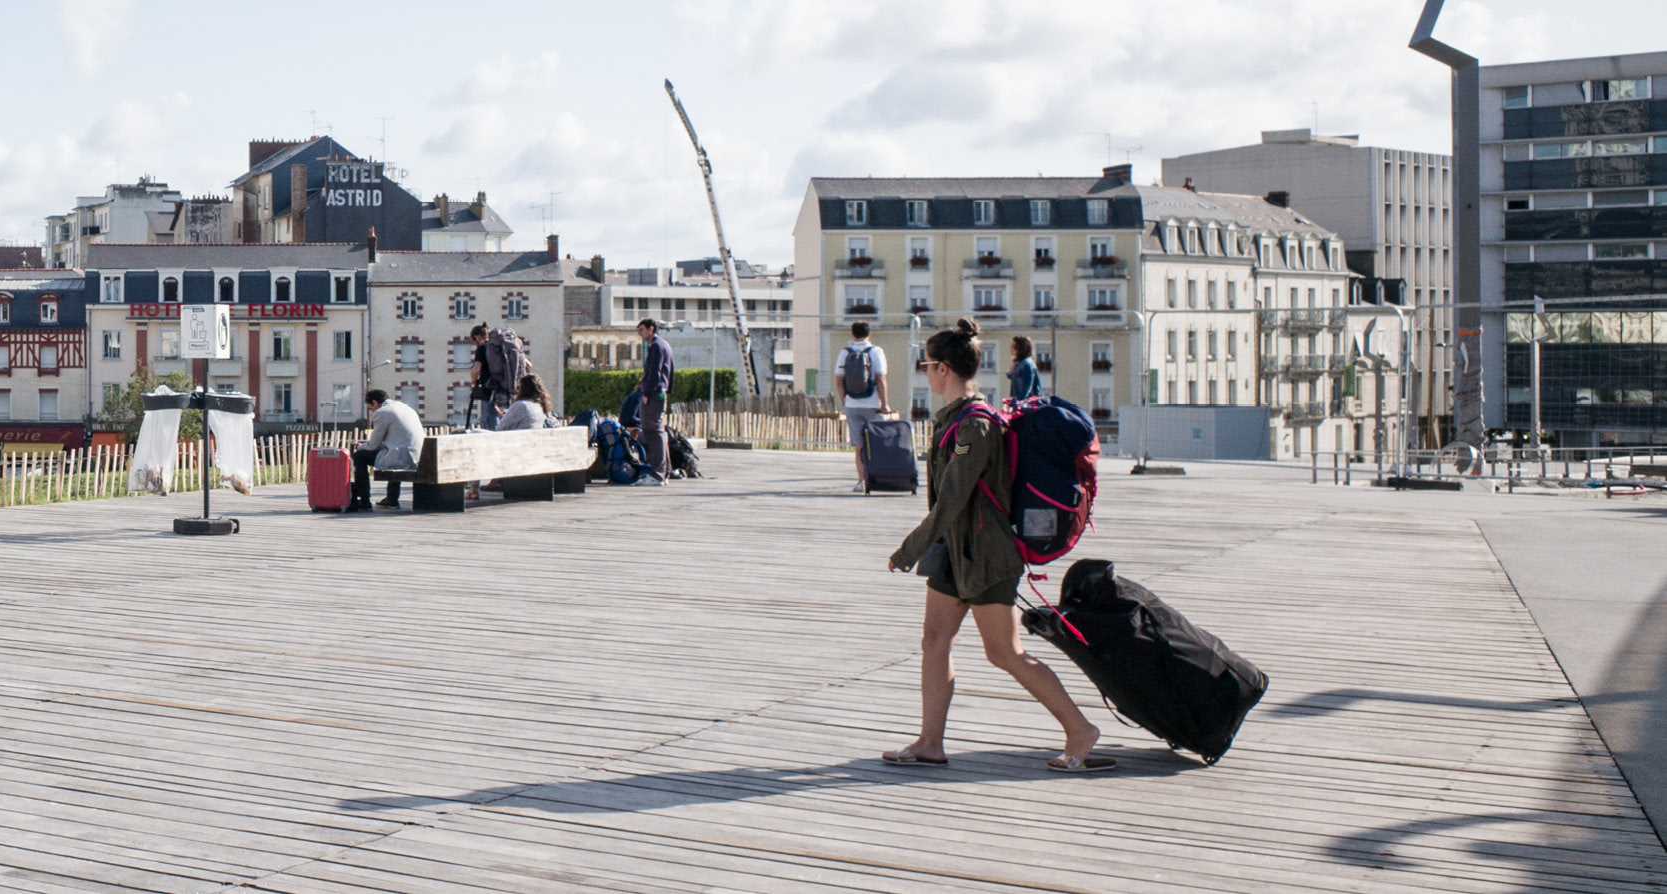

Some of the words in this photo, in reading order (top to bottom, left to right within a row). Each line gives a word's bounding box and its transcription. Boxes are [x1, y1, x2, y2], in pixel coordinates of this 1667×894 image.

[328, 165, 381, 183] HOTEL
[326, 189, 382, 206] ASTRID
[248, 303, 324, 317] FLORIN
